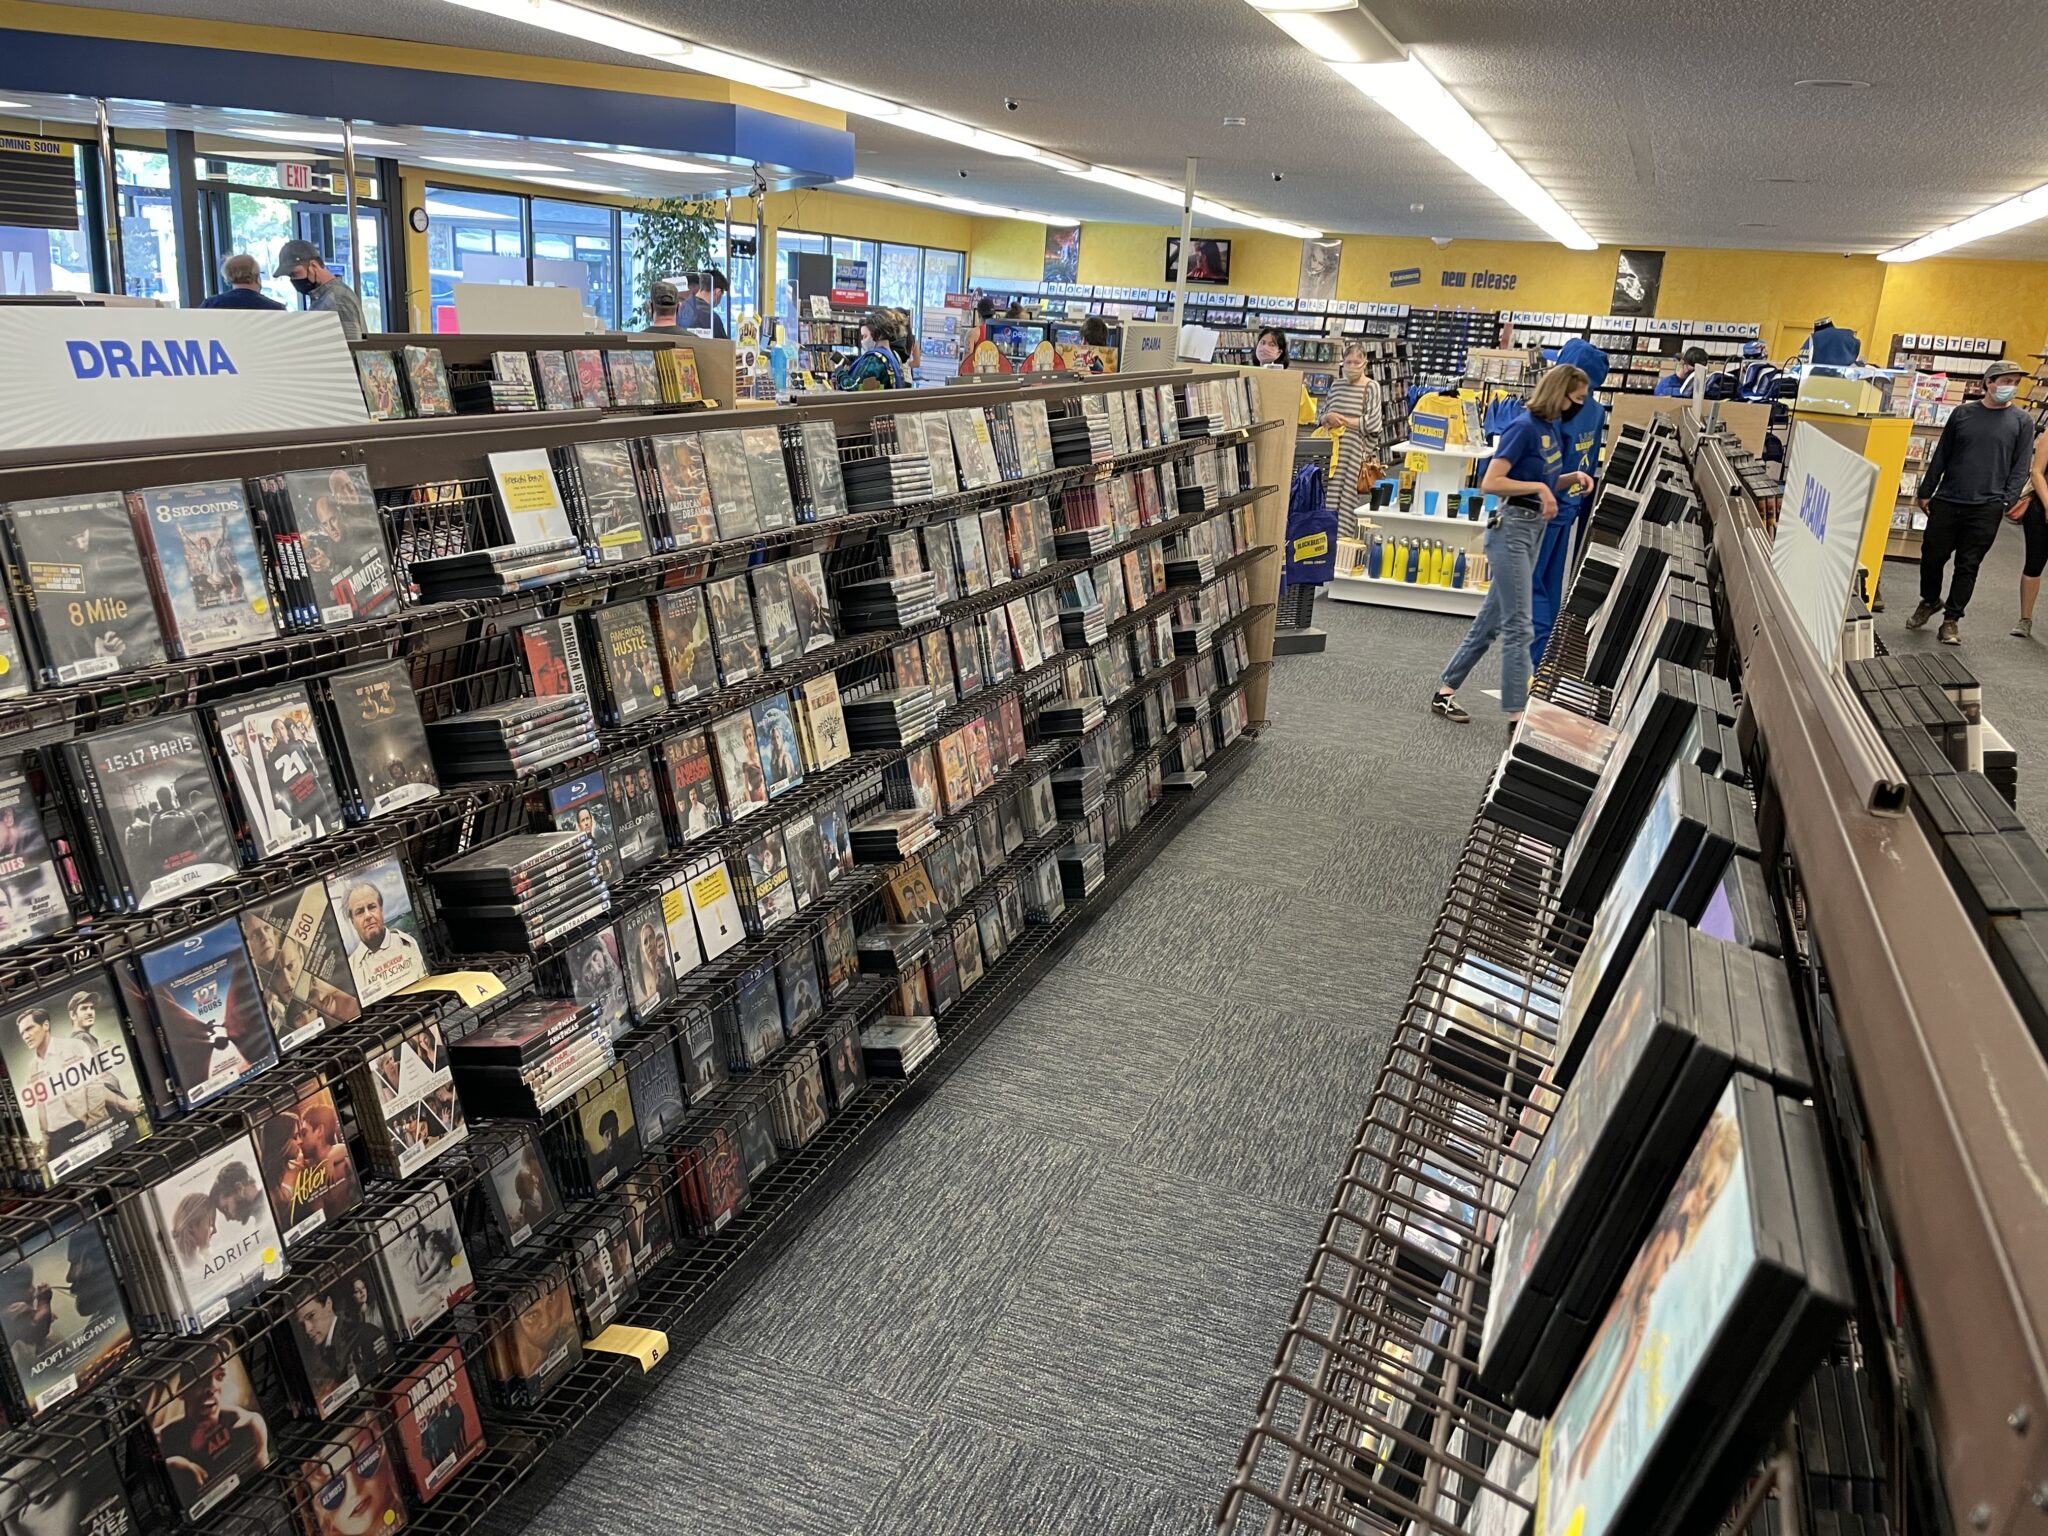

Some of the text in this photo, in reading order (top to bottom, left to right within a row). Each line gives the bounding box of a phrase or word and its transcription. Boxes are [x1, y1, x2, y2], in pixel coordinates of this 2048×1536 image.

[0, 138, 60, 154] OMING SOON
[286, 164, 308, 189] EXIT
[1441, 269, 1517, 290] new release
[1200, 293, 1236, 304] LAST
[1369, 304, 1398, 314] THE
[1604, 318, 1632, 329] THE
[1650, 321, 1691, 332] LAST
[1705, 324, 1758, 335] BLOCK
[1141, 337, 1162, 351] DRAMA
[1904, 336, 1987, 351] BUSTER
[65, 339, 239, 380] DRAMA
[155, 500, 239, 523] 8 SECONDS
[1799, 472, 1831, 545] DRAMA
[349, 557, 386, 595] MINUTES
[370, 572, 390, 595] GONE
[68, 597, 128, 627] 8 Mile
[561, 621, 581, 672] AMERICAN
[609, 624, 648, 657] AMERICAN HUSTLE
[105, 736, 194, 774] 15:17 PARIS
[274, 750, 307, 783] 21
[88, 776, 104, 809] PARIS
[0, 856, 25, 875] UTES
[294, 913, 314, 941] 360
[554, 914, 588, 936] ARBITRAGE
[626, 908, 656, 932] ARRIVAL
[389, 957, 412, 977] SCHMIDT
[192, 981, 218, 1007] 127
[476, 984, 488, 996] A
[198, 999, 223, 1015] HOURS
[545, 1050, 568, 1069] ARTHUR
[553, 1055, 576, 1074] ARTHUR
[21, 1044, 127, 1108] 99 HOMES
[388, 1073, 450, 1117] AFTER THE WEDDING
[290, 1159, 329, 1226] After
[203, 1229, 262, 1280] ADRIFT
[636, 1241, 674, 1281] DIARIES
[30, 1348, 64, 1377] ADOPT
[72, 1315, 117, 1348] HIGHWAY
[652, 1349, 659, 1361] B
[207, 1426, 230, 1455] ALI
[356, 1450, 381, 1475] FAMOUS
[322, 1480, 346, 1507] ALMOST
